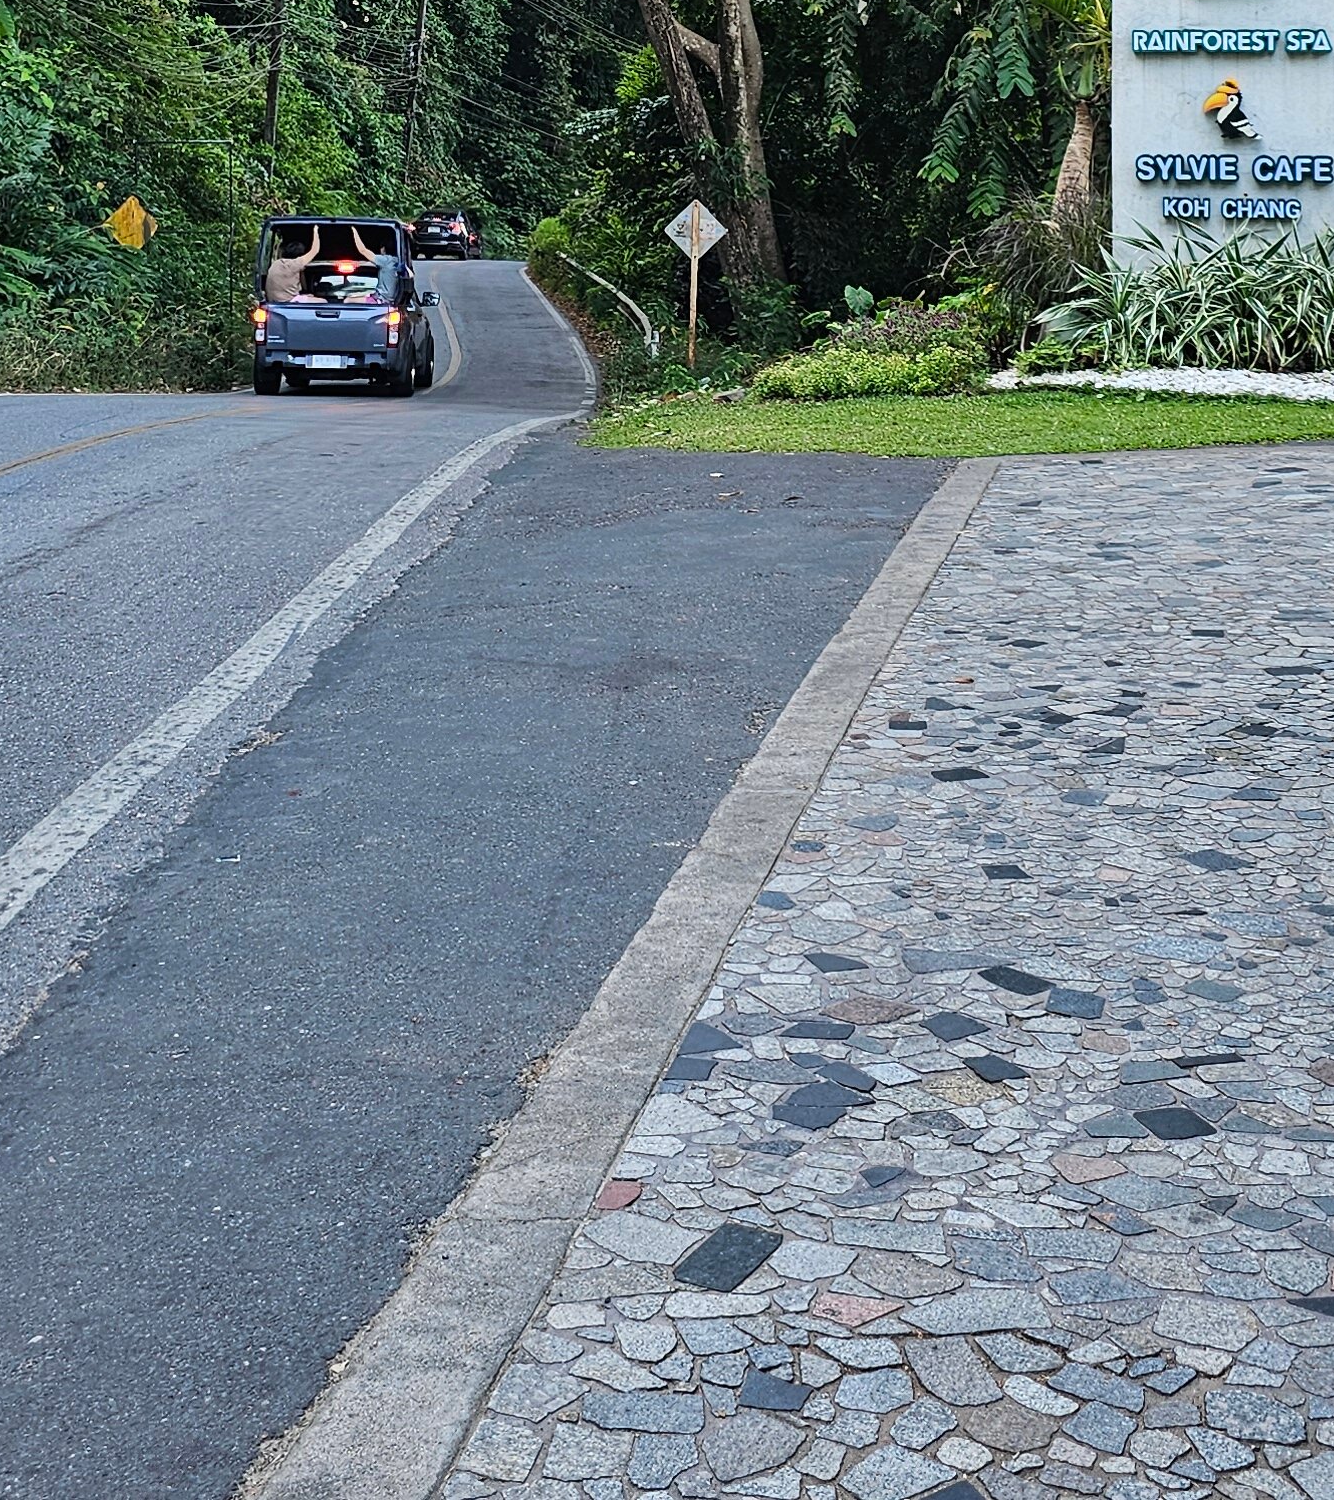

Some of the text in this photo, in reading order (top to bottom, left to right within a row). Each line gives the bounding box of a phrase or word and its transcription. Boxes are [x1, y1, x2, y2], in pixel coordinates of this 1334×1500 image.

[1133, 30, 1331, 52] RAINFOREST SPA
[1136, 156, 1333, 182] SYLVIE CAFE
[1163, 198, 1301, 219] KOH CHANG
